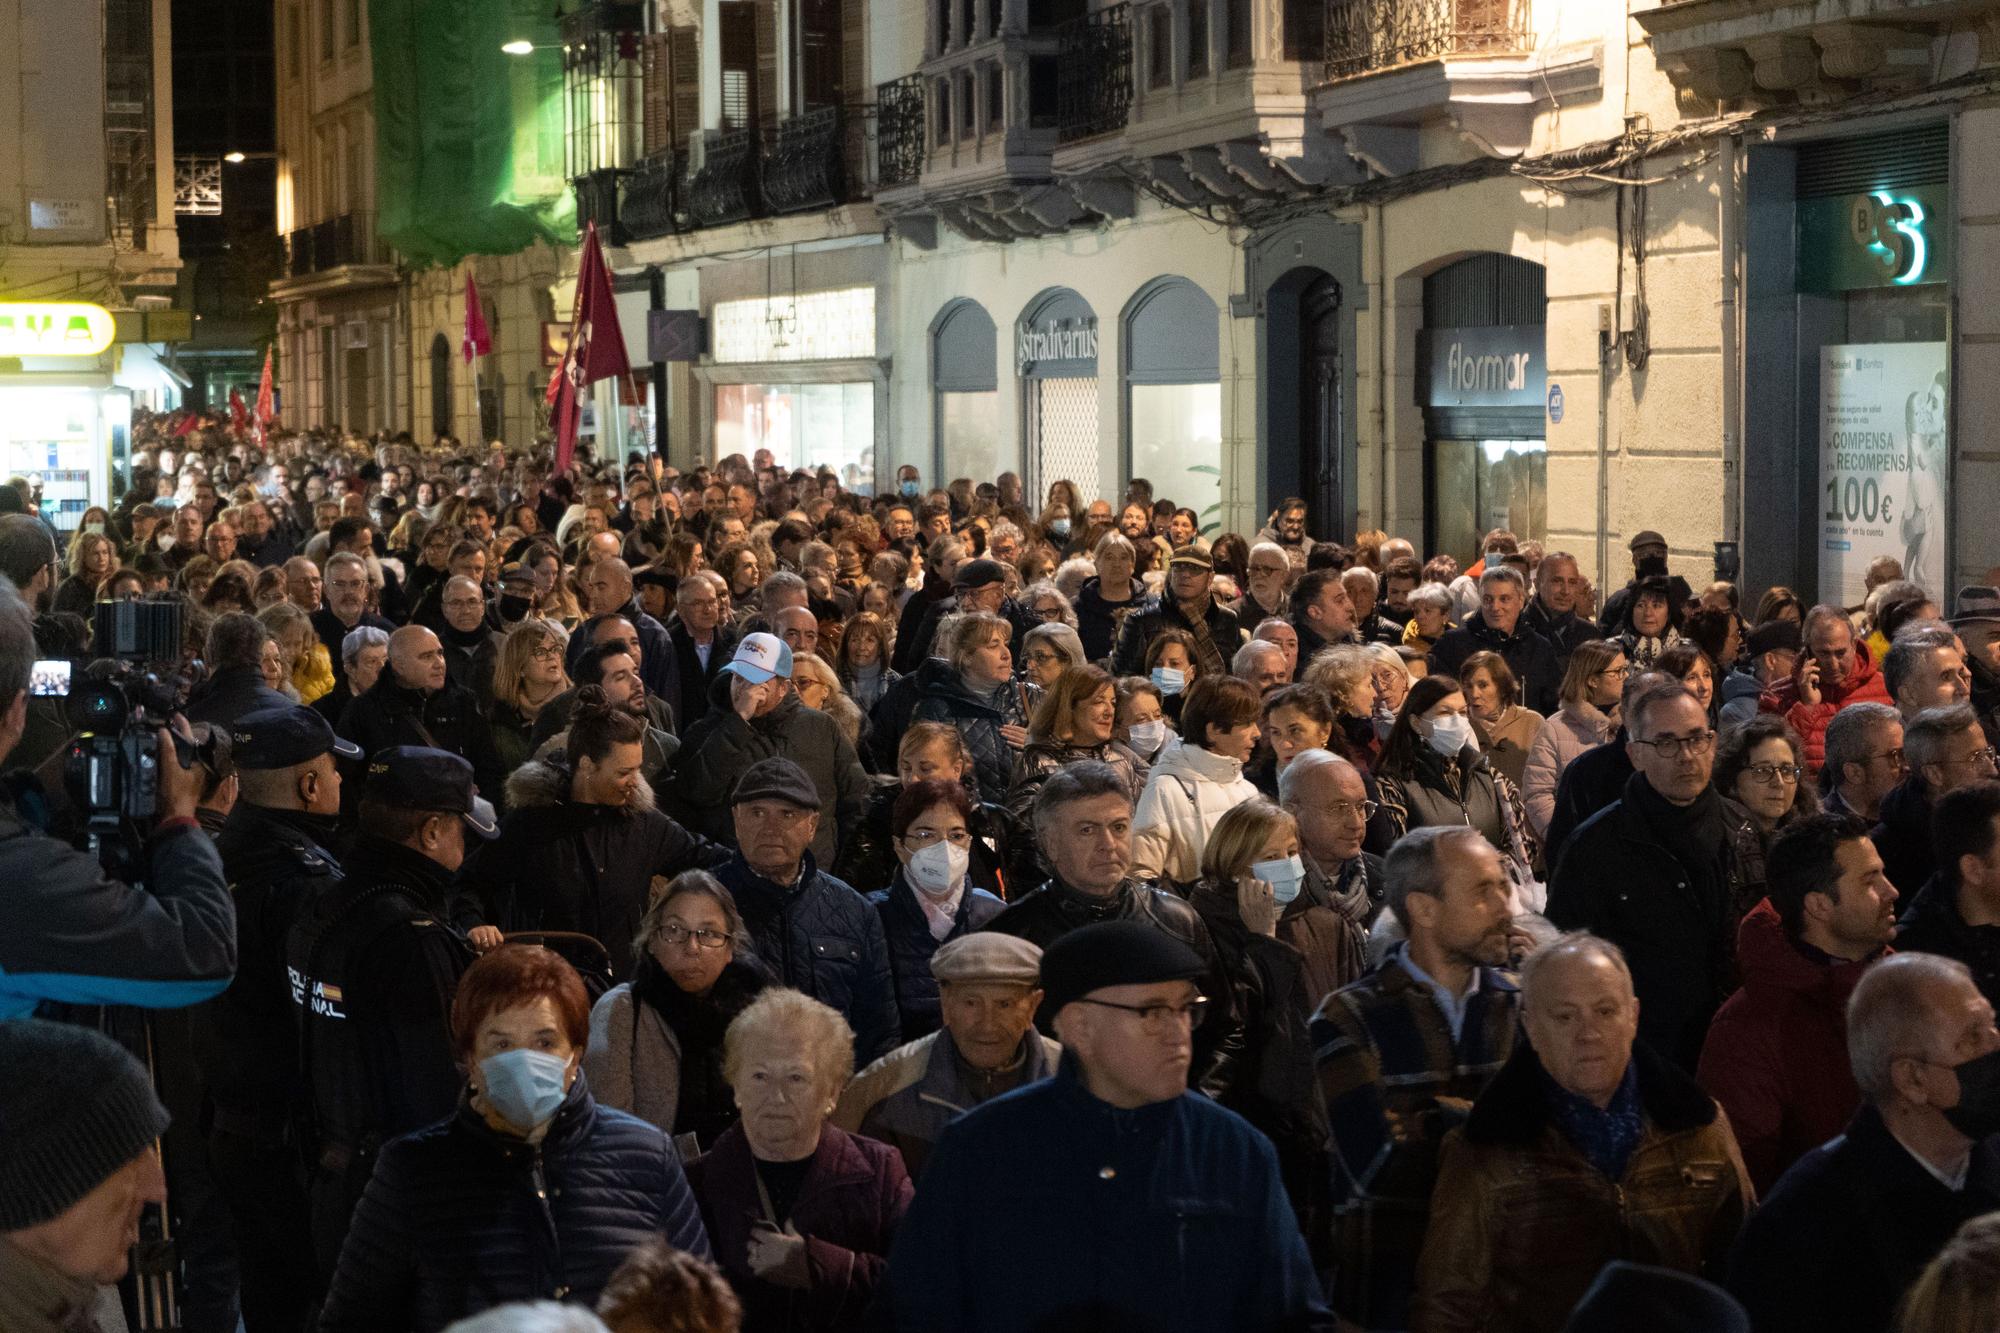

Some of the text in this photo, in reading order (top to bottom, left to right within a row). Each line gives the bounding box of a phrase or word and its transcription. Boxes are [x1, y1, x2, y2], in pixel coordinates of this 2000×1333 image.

[1022, 319, 1098, 361] stradivarius
[1447, 342, 1530, 391] flormar
[1832, 431, 1895, 450] COMPENSA
[1836, 453, 1914, 472] RECOMPENSA
